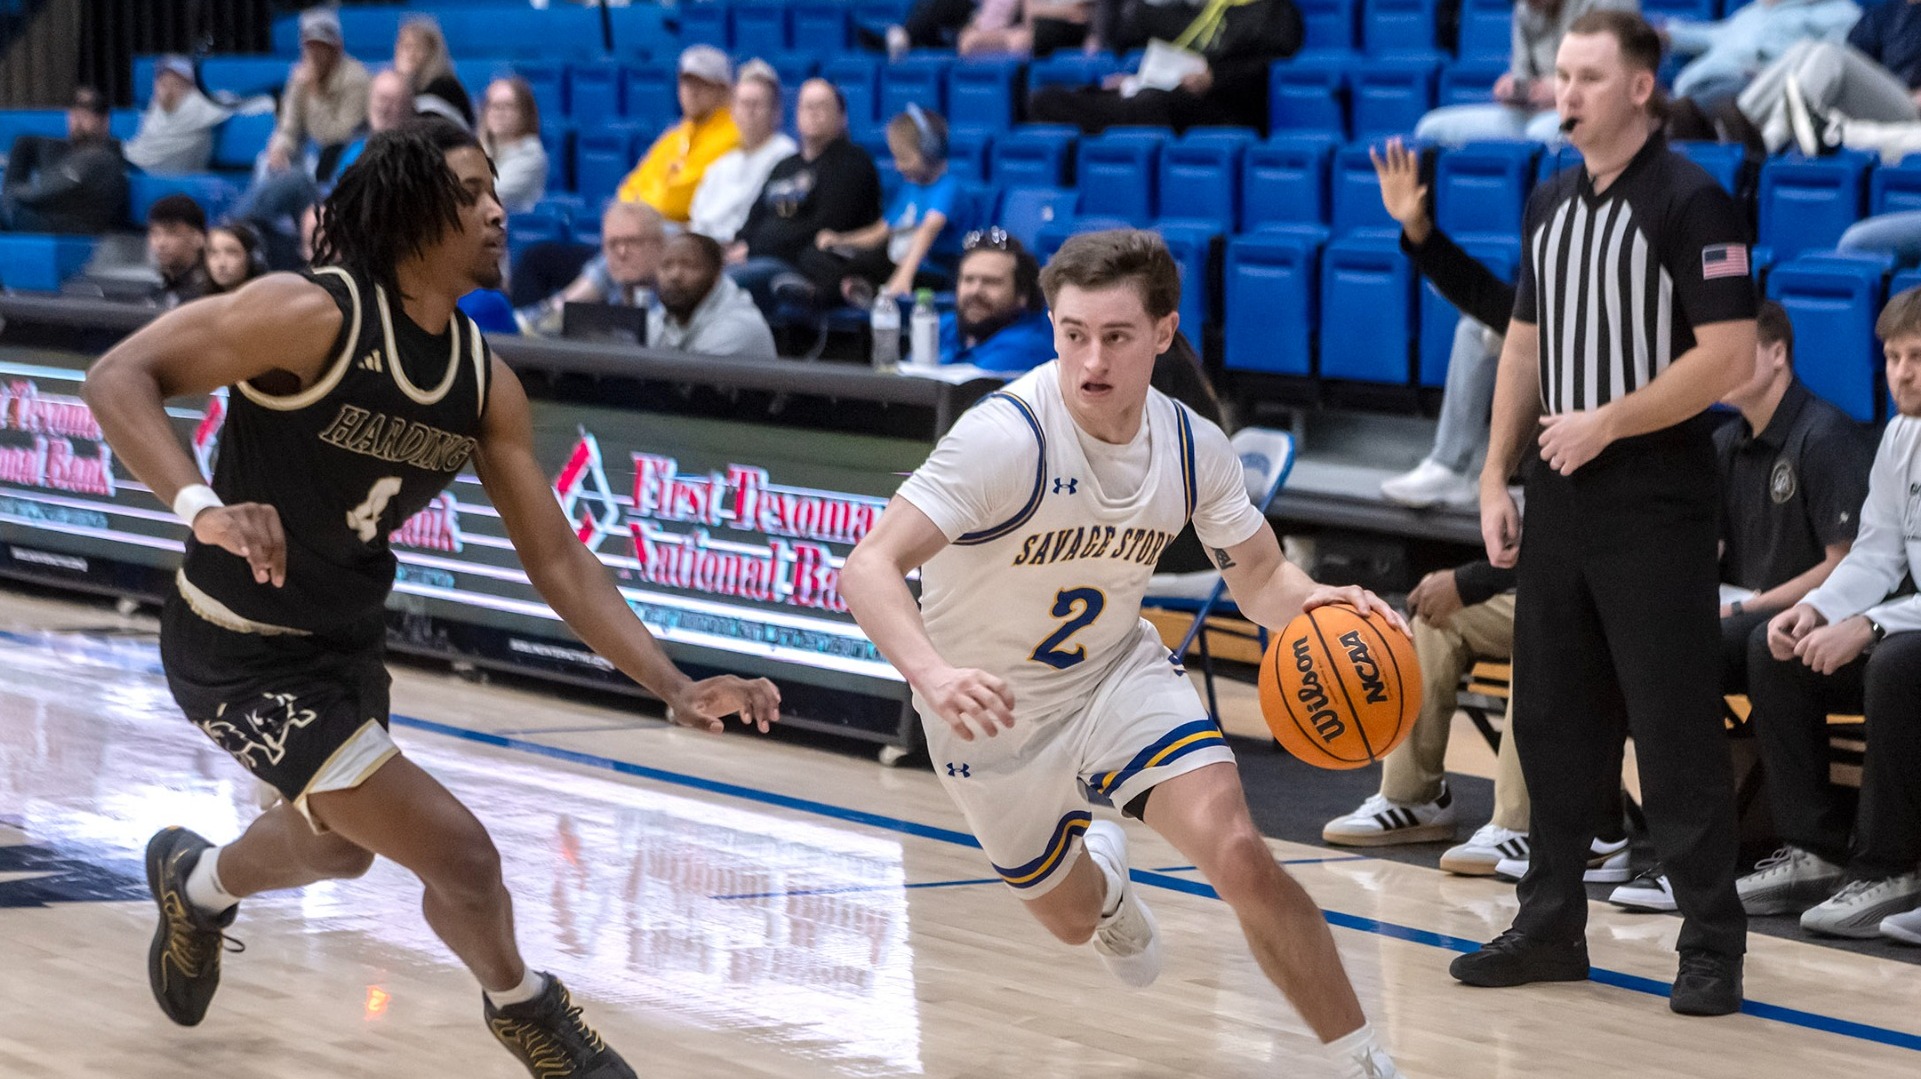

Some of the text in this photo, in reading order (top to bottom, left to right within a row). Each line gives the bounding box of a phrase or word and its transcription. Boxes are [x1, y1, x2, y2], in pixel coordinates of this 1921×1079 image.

[346, 476, 403, 543] 4
[630, 451, 886, 546] First Texoma
[621, 515, 853, 614] National Ba
[1011, 525, 1116, 567] SAVAGE
[1026, 584, 1107, 671] 2
[1338, 629, 1388, 705] NCAA
[1292, 635, 1346, 744] Wilson
